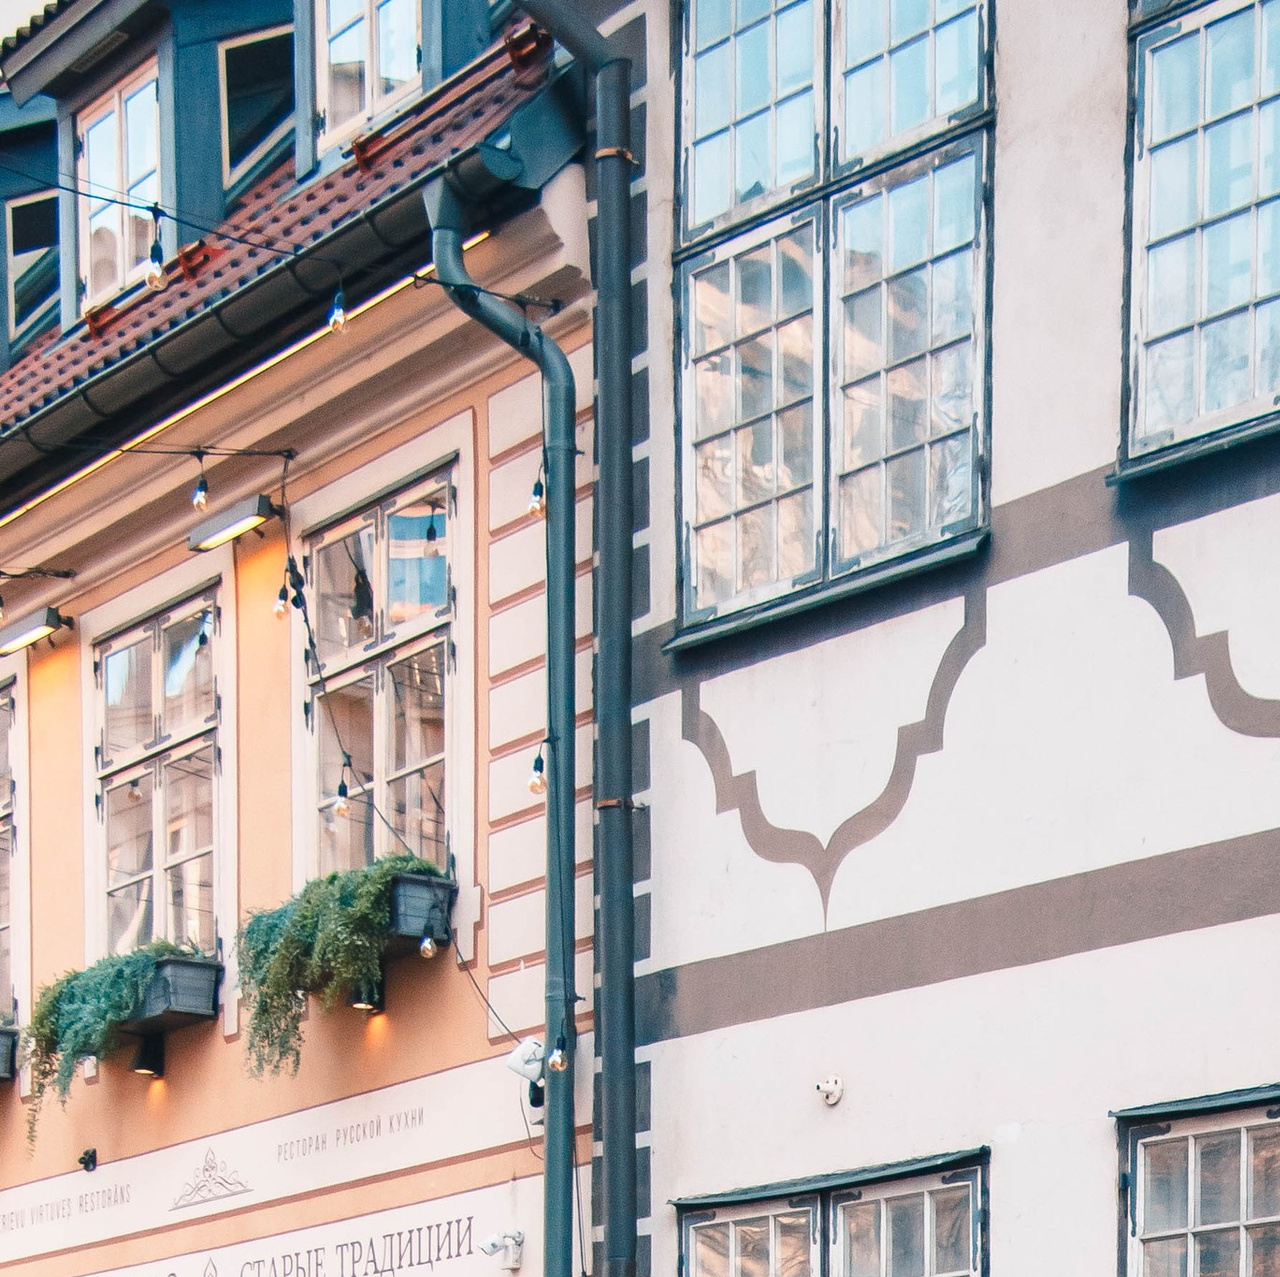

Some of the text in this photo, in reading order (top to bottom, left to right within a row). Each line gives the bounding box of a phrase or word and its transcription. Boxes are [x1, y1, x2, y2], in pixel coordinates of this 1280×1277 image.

[278, 1107, 424, 1162] РЕСТОРАН РУССКОЙ КУХНИ
[0, 1208, 25, 1233] RIEVU
[79, 1183, 131, 1214] RESTORĀNS
